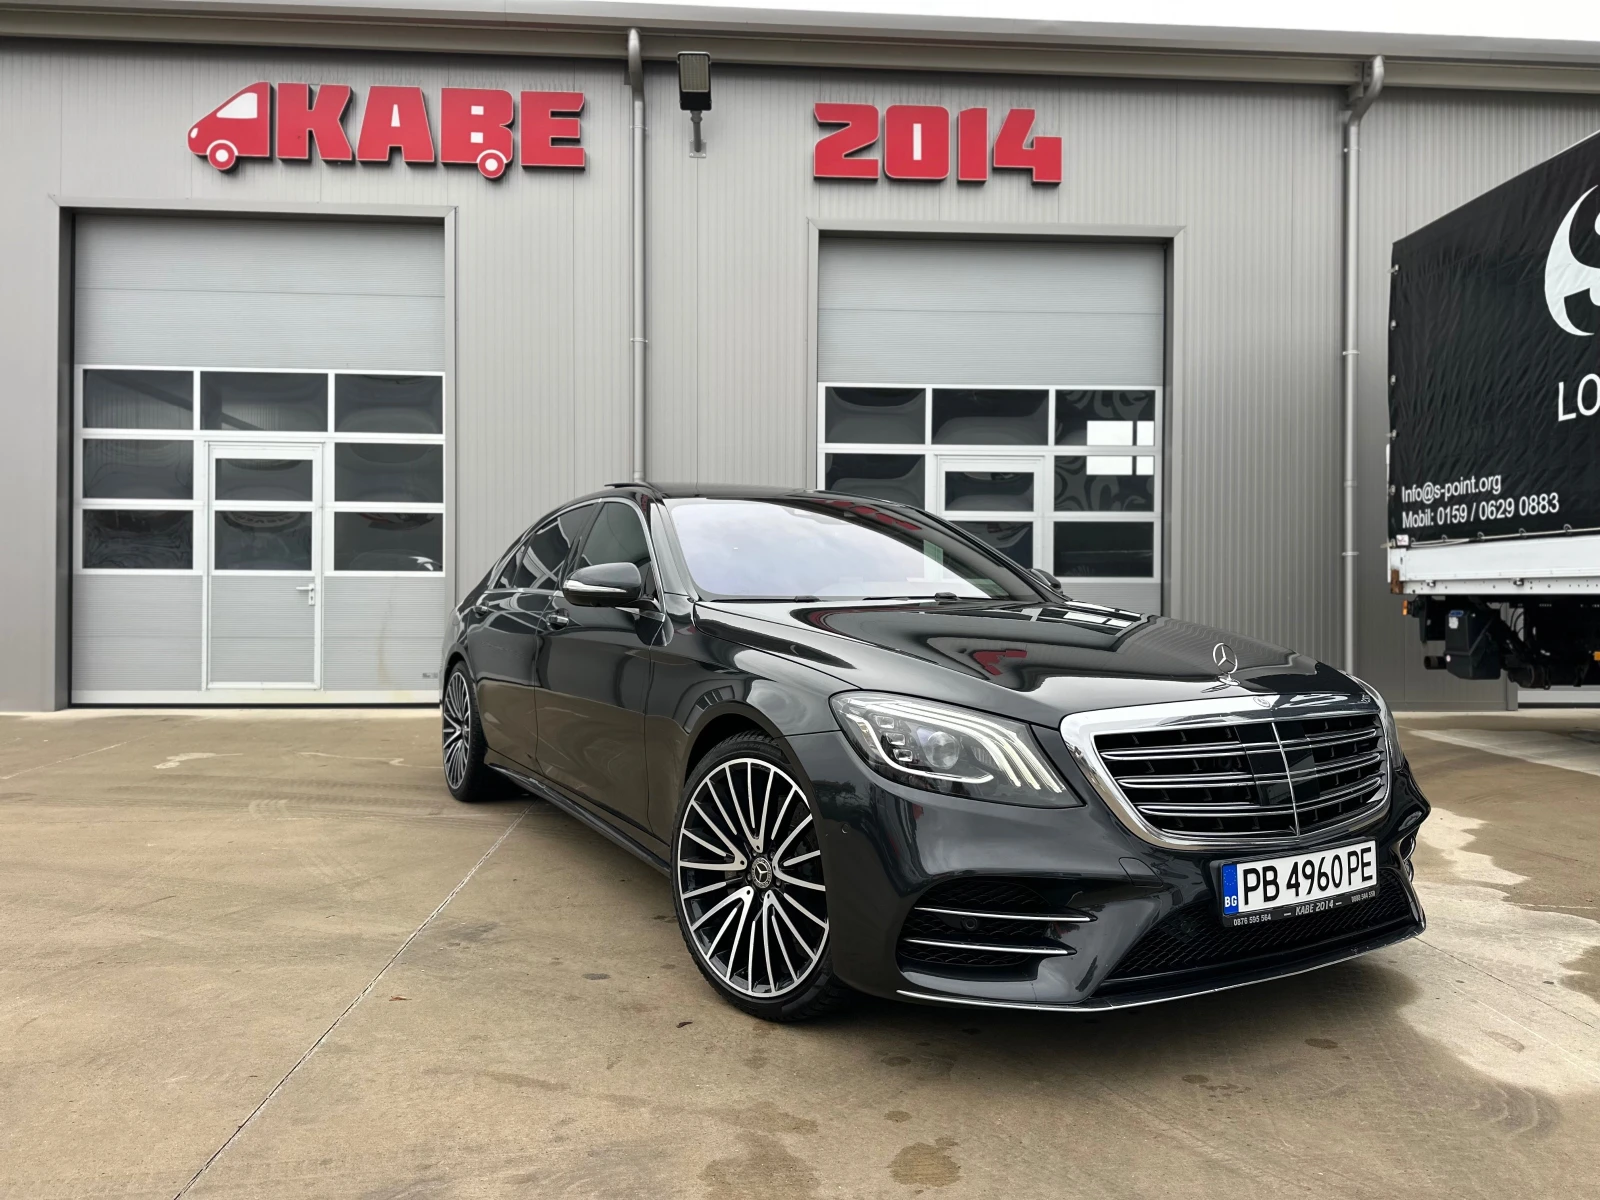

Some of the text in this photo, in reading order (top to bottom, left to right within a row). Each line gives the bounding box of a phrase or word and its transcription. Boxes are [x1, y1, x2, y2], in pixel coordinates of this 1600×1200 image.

[276, 82, 1062, 182] KABE 2014
[1402, 475, 1501, 504] Info@s-point.org
[1402, 508, 1434, 528] Mobil:
[1437, 504, 1467, 525] 0159
[1479, 498, 1515, 520] 0629
[1519, 492, 1559, 516] 0883
[1243, 847, 1373, 906] PB 4960 PE
[1225, 895, 1237, 908] BG
[1296, 900, 1333, 916] KABE 2014
